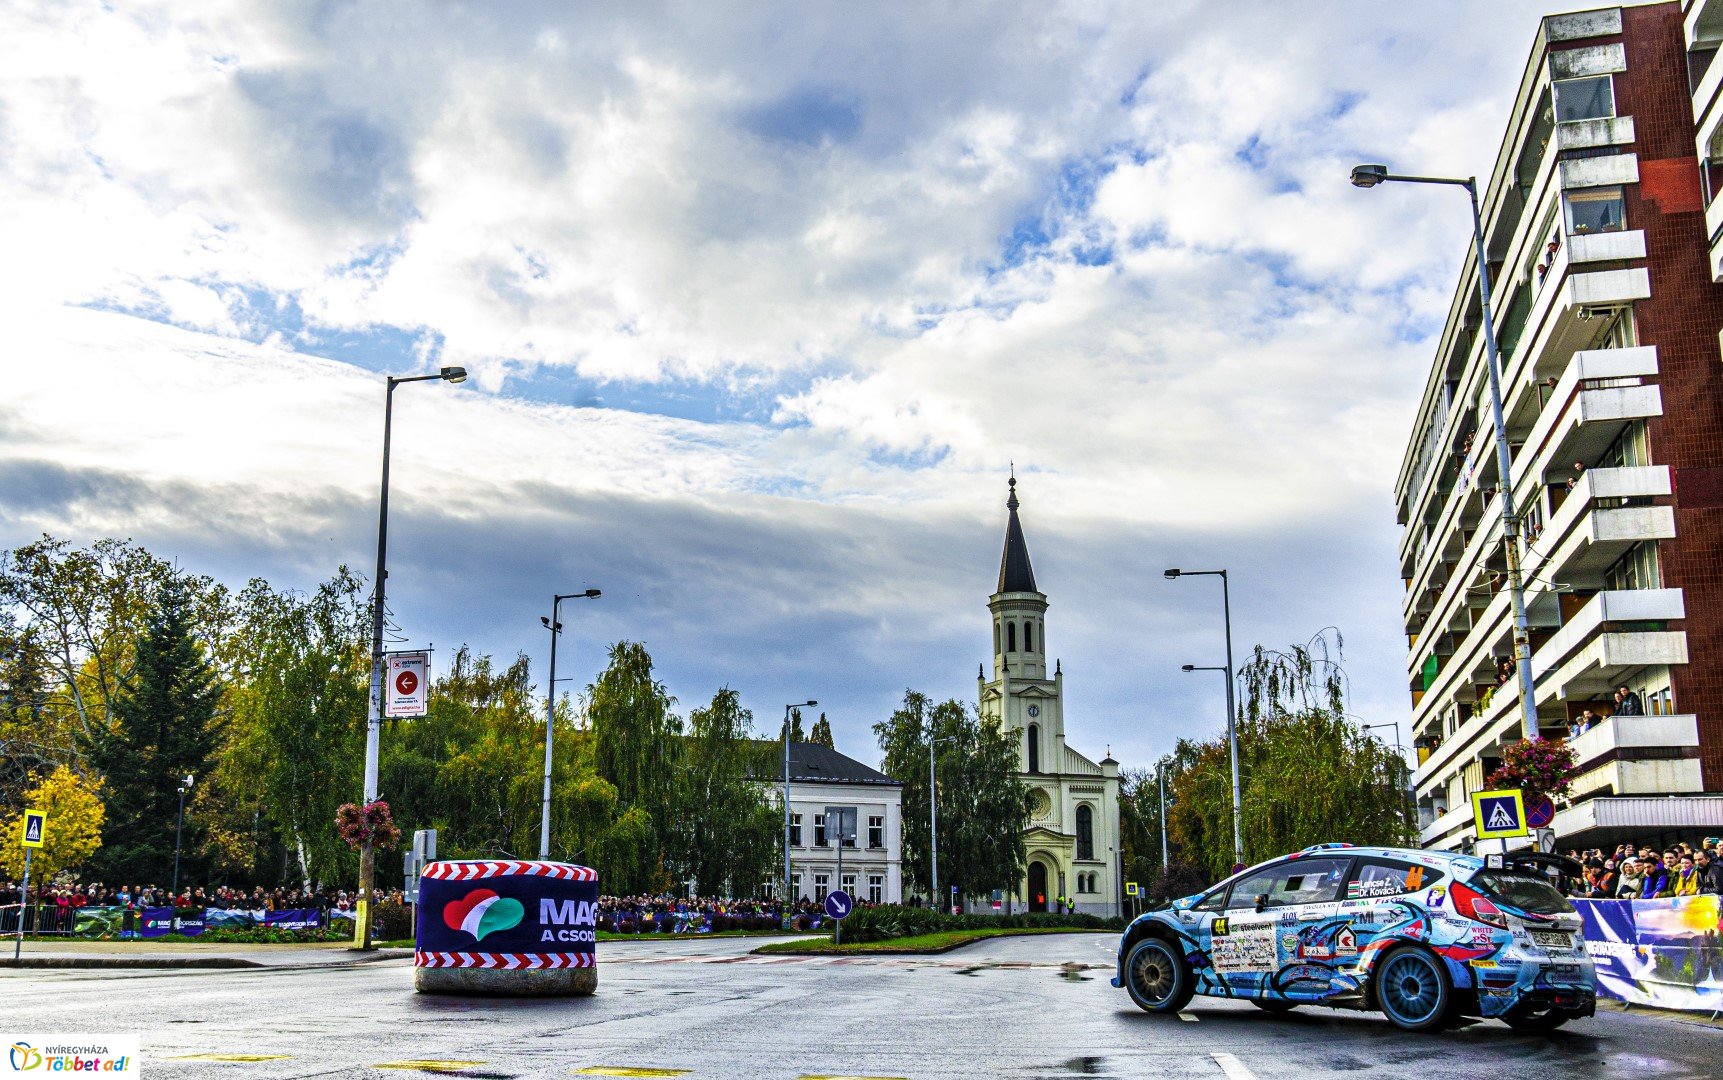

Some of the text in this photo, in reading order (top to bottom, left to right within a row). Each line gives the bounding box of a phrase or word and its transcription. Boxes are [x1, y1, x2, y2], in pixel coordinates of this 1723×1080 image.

[1360, 877, 1391, 888] Lencse Z.
[1405, 866, 1424, 891] 44
[1359, 884, 1403, 897] Dr. Kovács A.
[540, 898, 598, 926] MAG
[1240, 923, 1272, 931] steelvent
[541, 929, 555, 942] A
